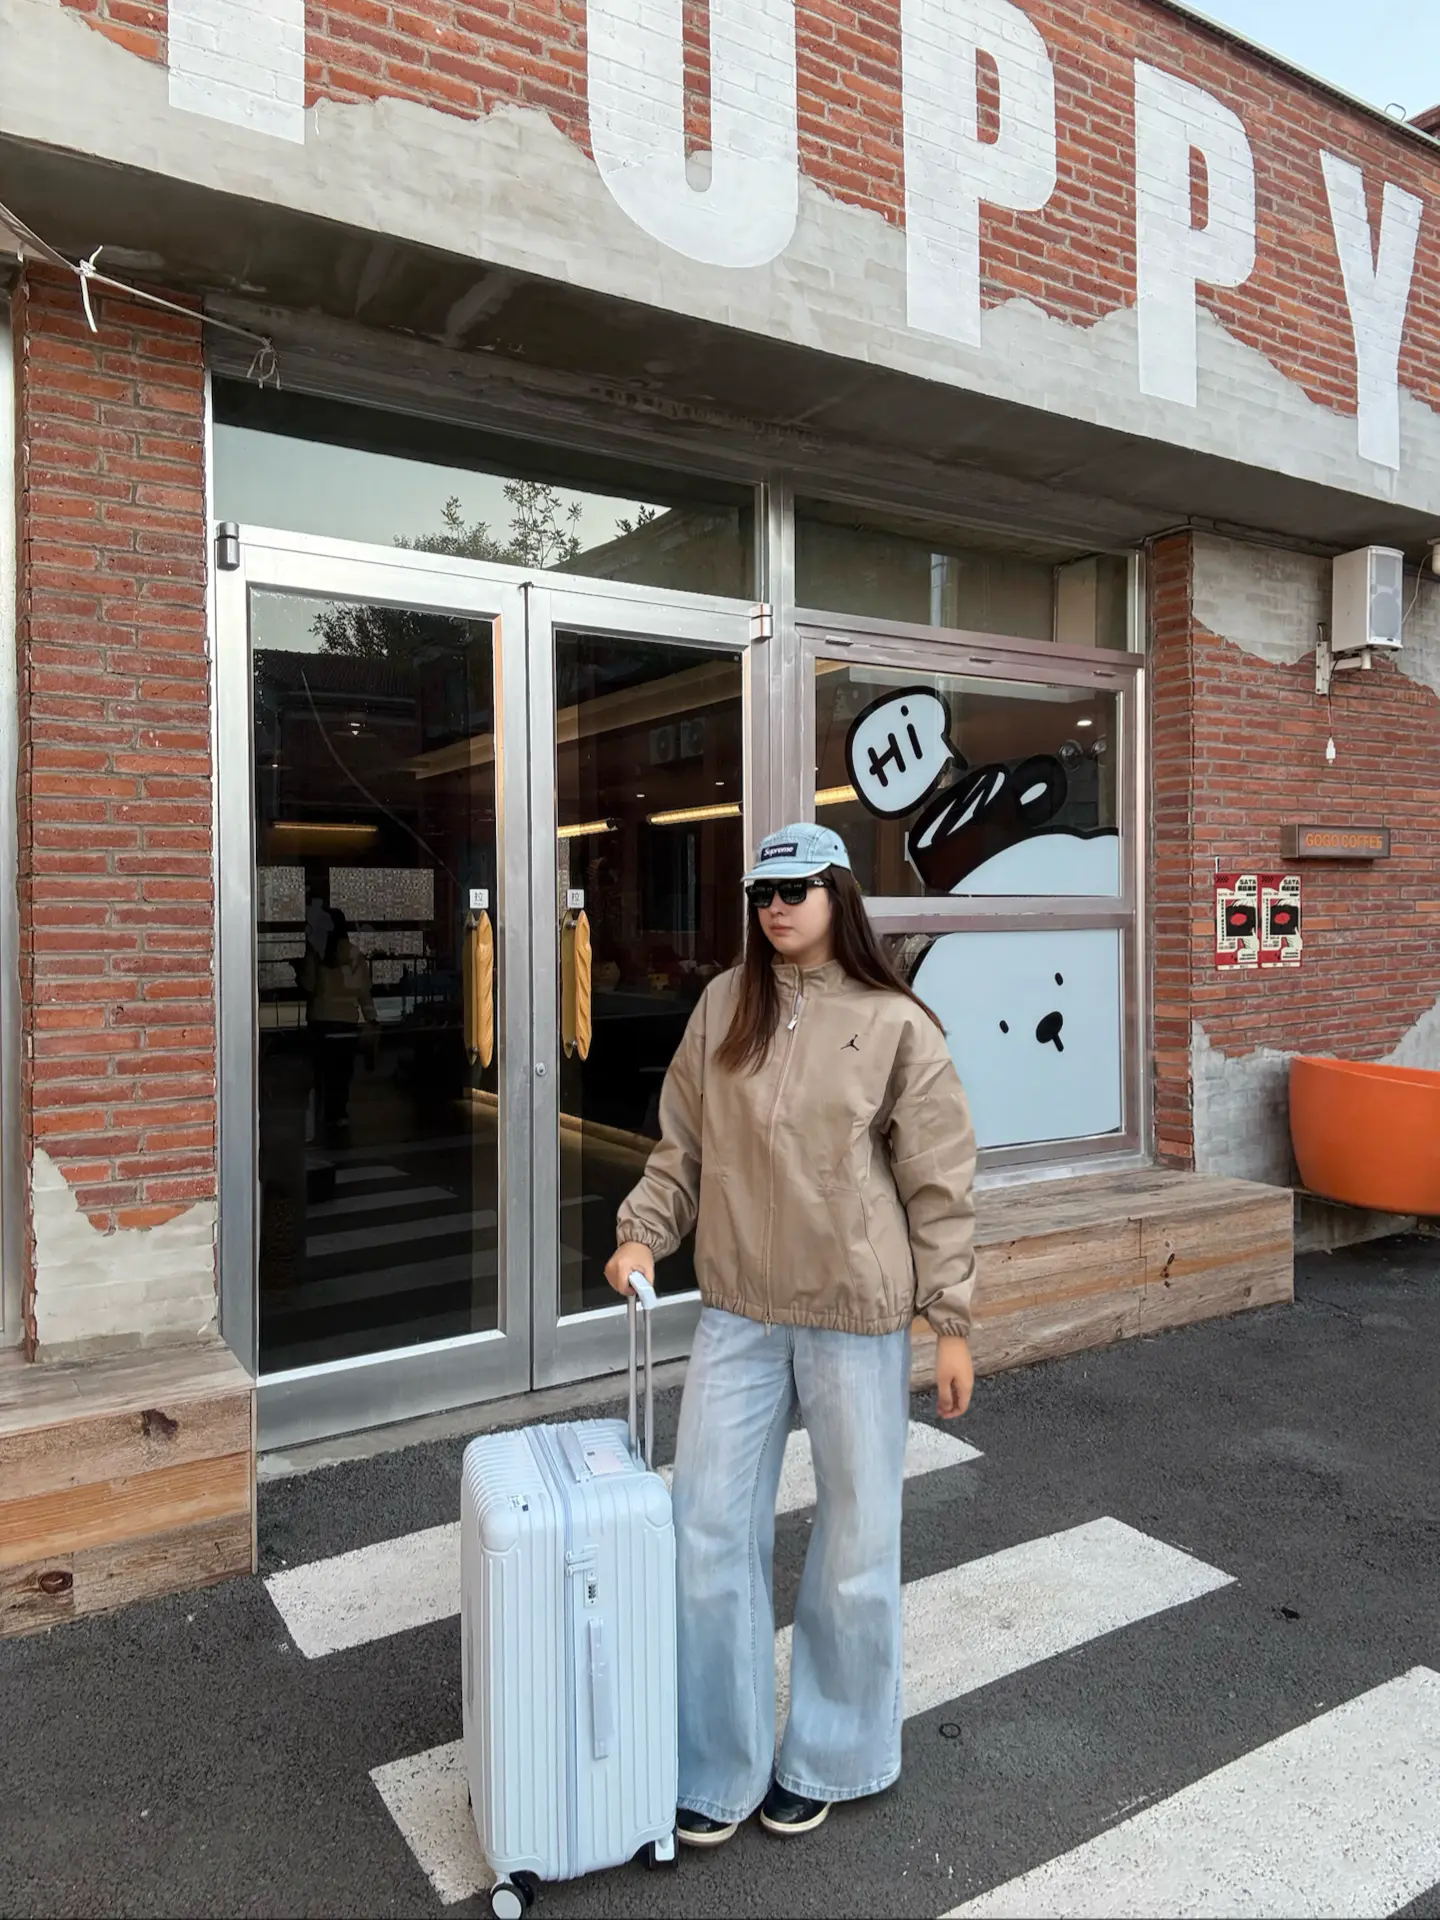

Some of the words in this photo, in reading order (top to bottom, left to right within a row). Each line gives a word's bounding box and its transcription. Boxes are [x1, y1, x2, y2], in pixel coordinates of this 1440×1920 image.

[1304, 832, 1340, 848] GOGO
[1341, 834, 1383, 849] COFFEE
[763, 846, 794, 857] Supreme
